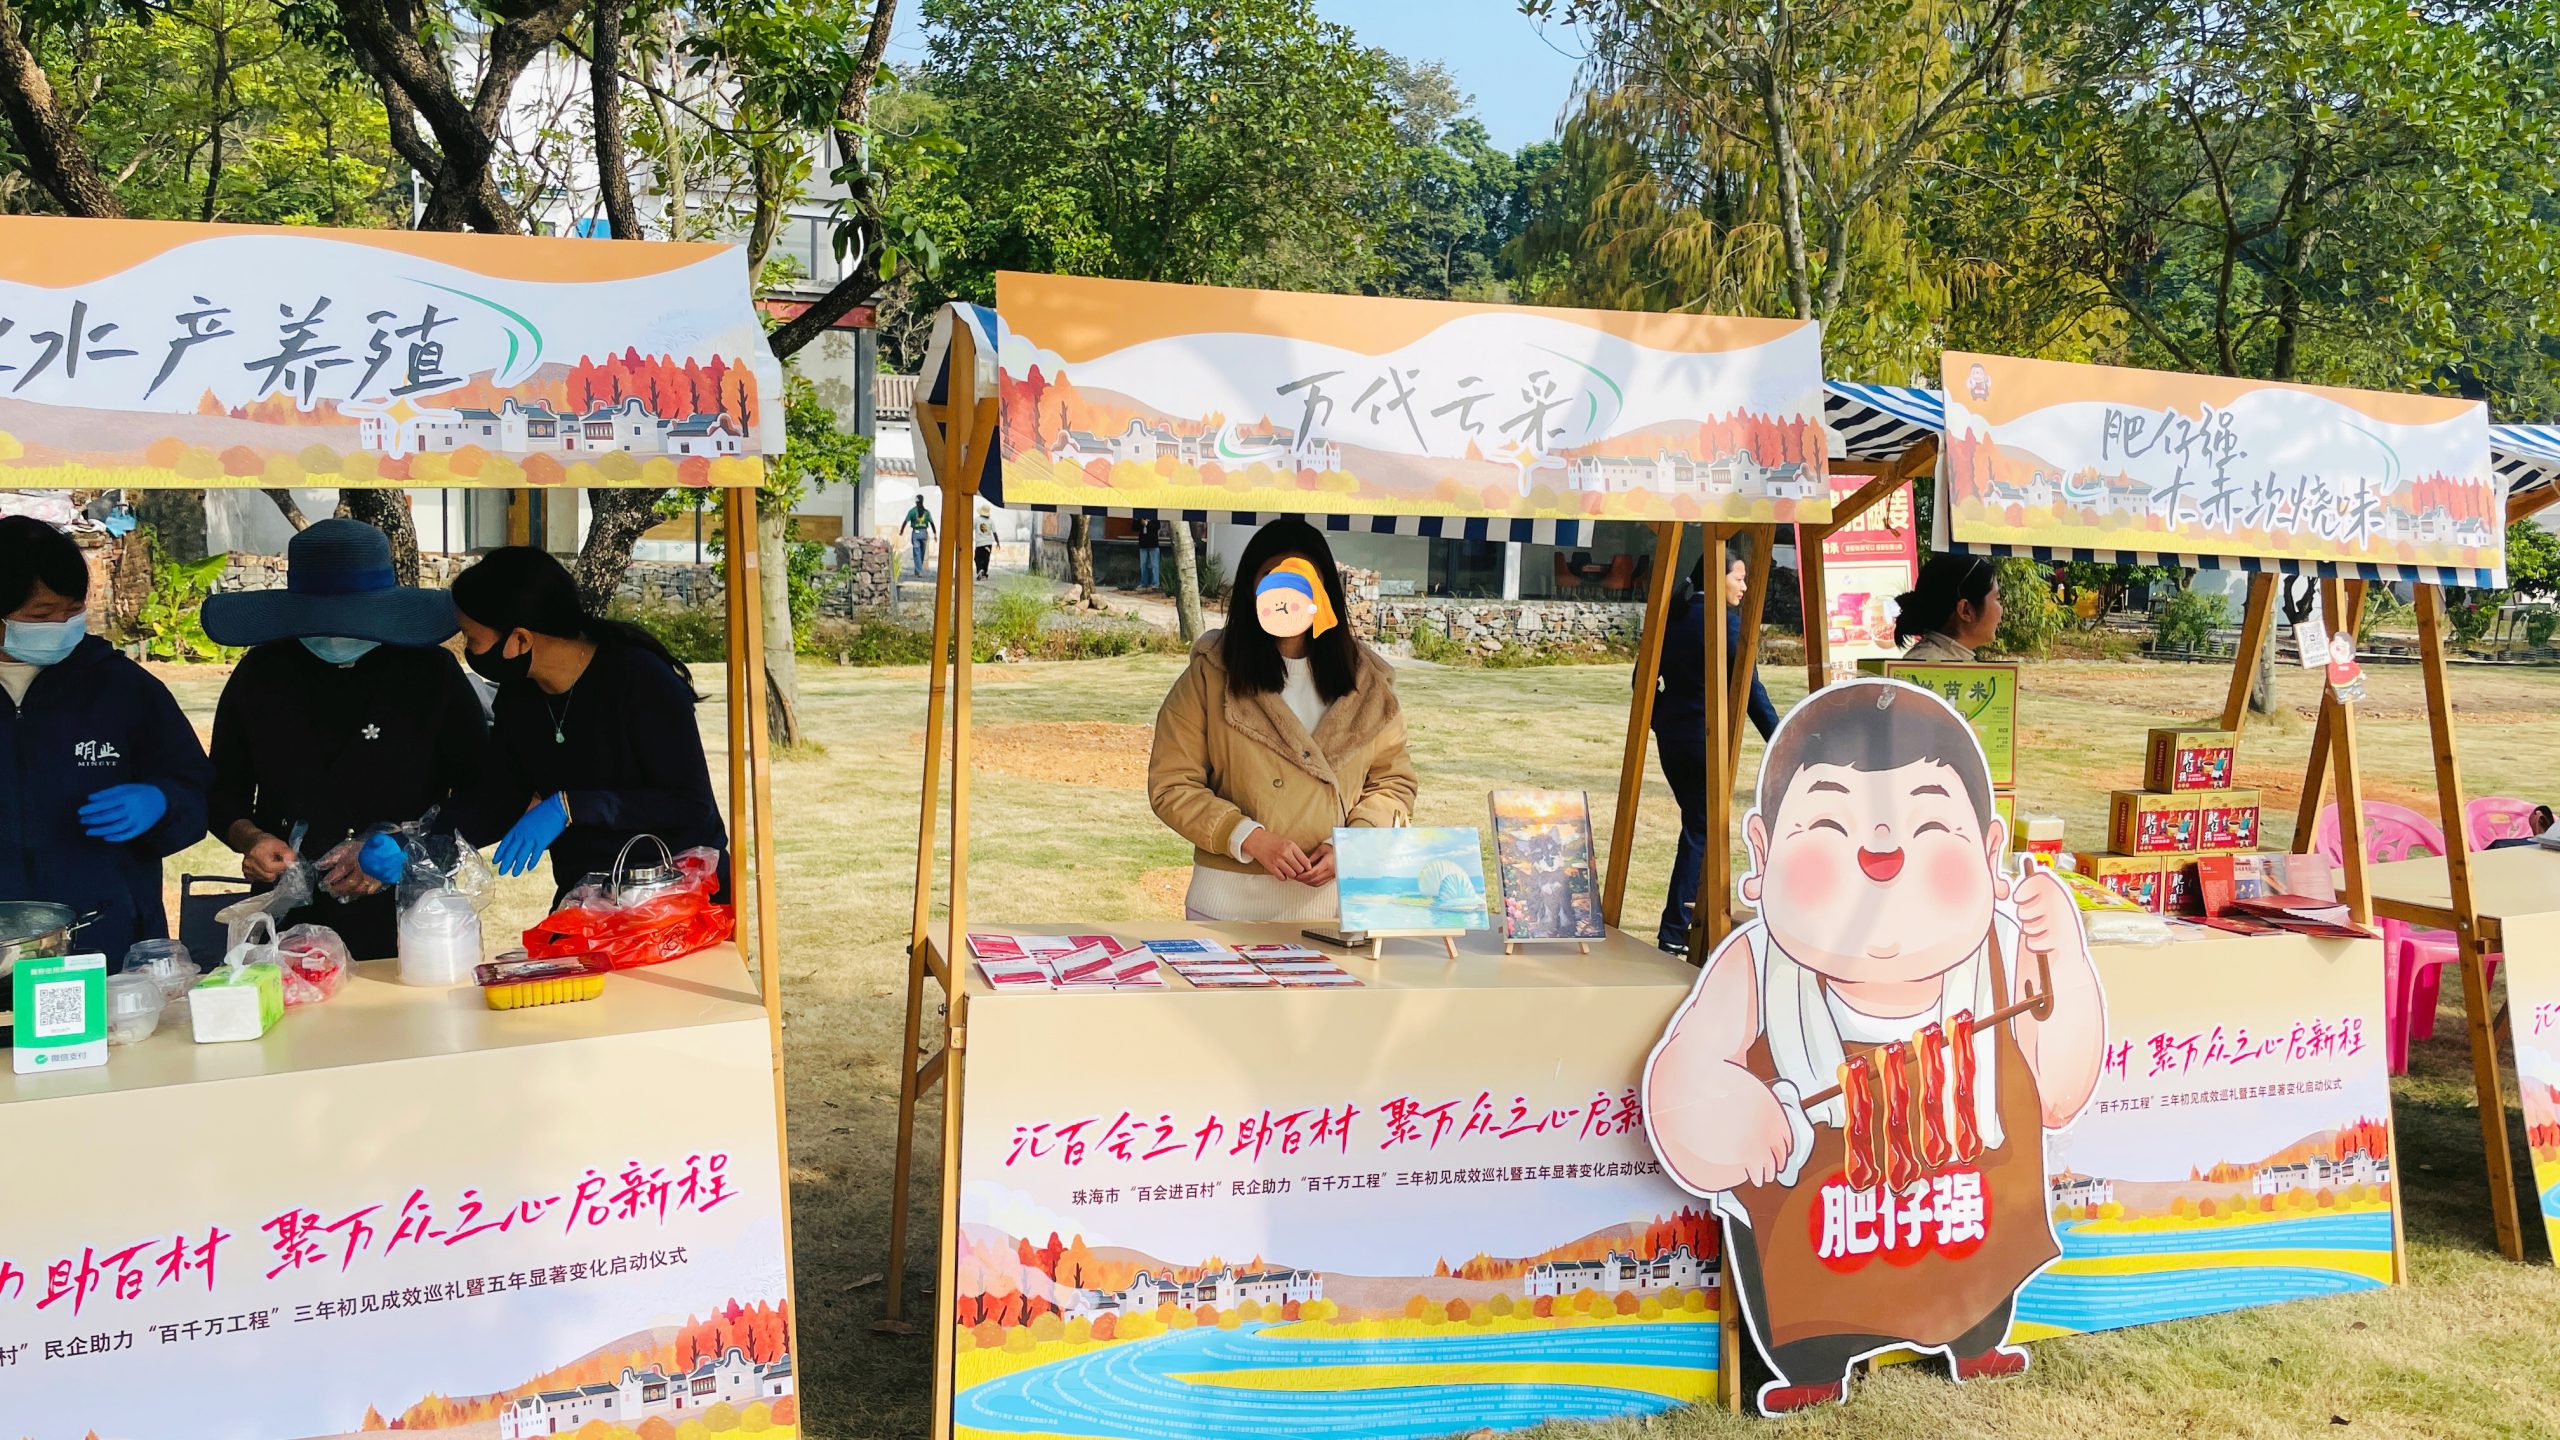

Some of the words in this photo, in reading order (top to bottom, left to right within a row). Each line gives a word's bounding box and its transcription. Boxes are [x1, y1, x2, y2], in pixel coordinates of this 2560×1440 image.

[1276, 366, 1574, 454] 万代云采
[2102, 405, 2248, 469] 肥仔强
[2152, 465, 2383, 545] 大赤坎烧味
[2148, 1018, 2367, 1078] 聚万众之心启新程
[2534, 1003, 2560, 1035] 汇
[1006, 1104, 1361, 1166] 汇百会之力助百村
[261, 1153, 740, 1279] 聚万众之心启新程
[1817, 1171, 1985, 1258] 肥仔强
